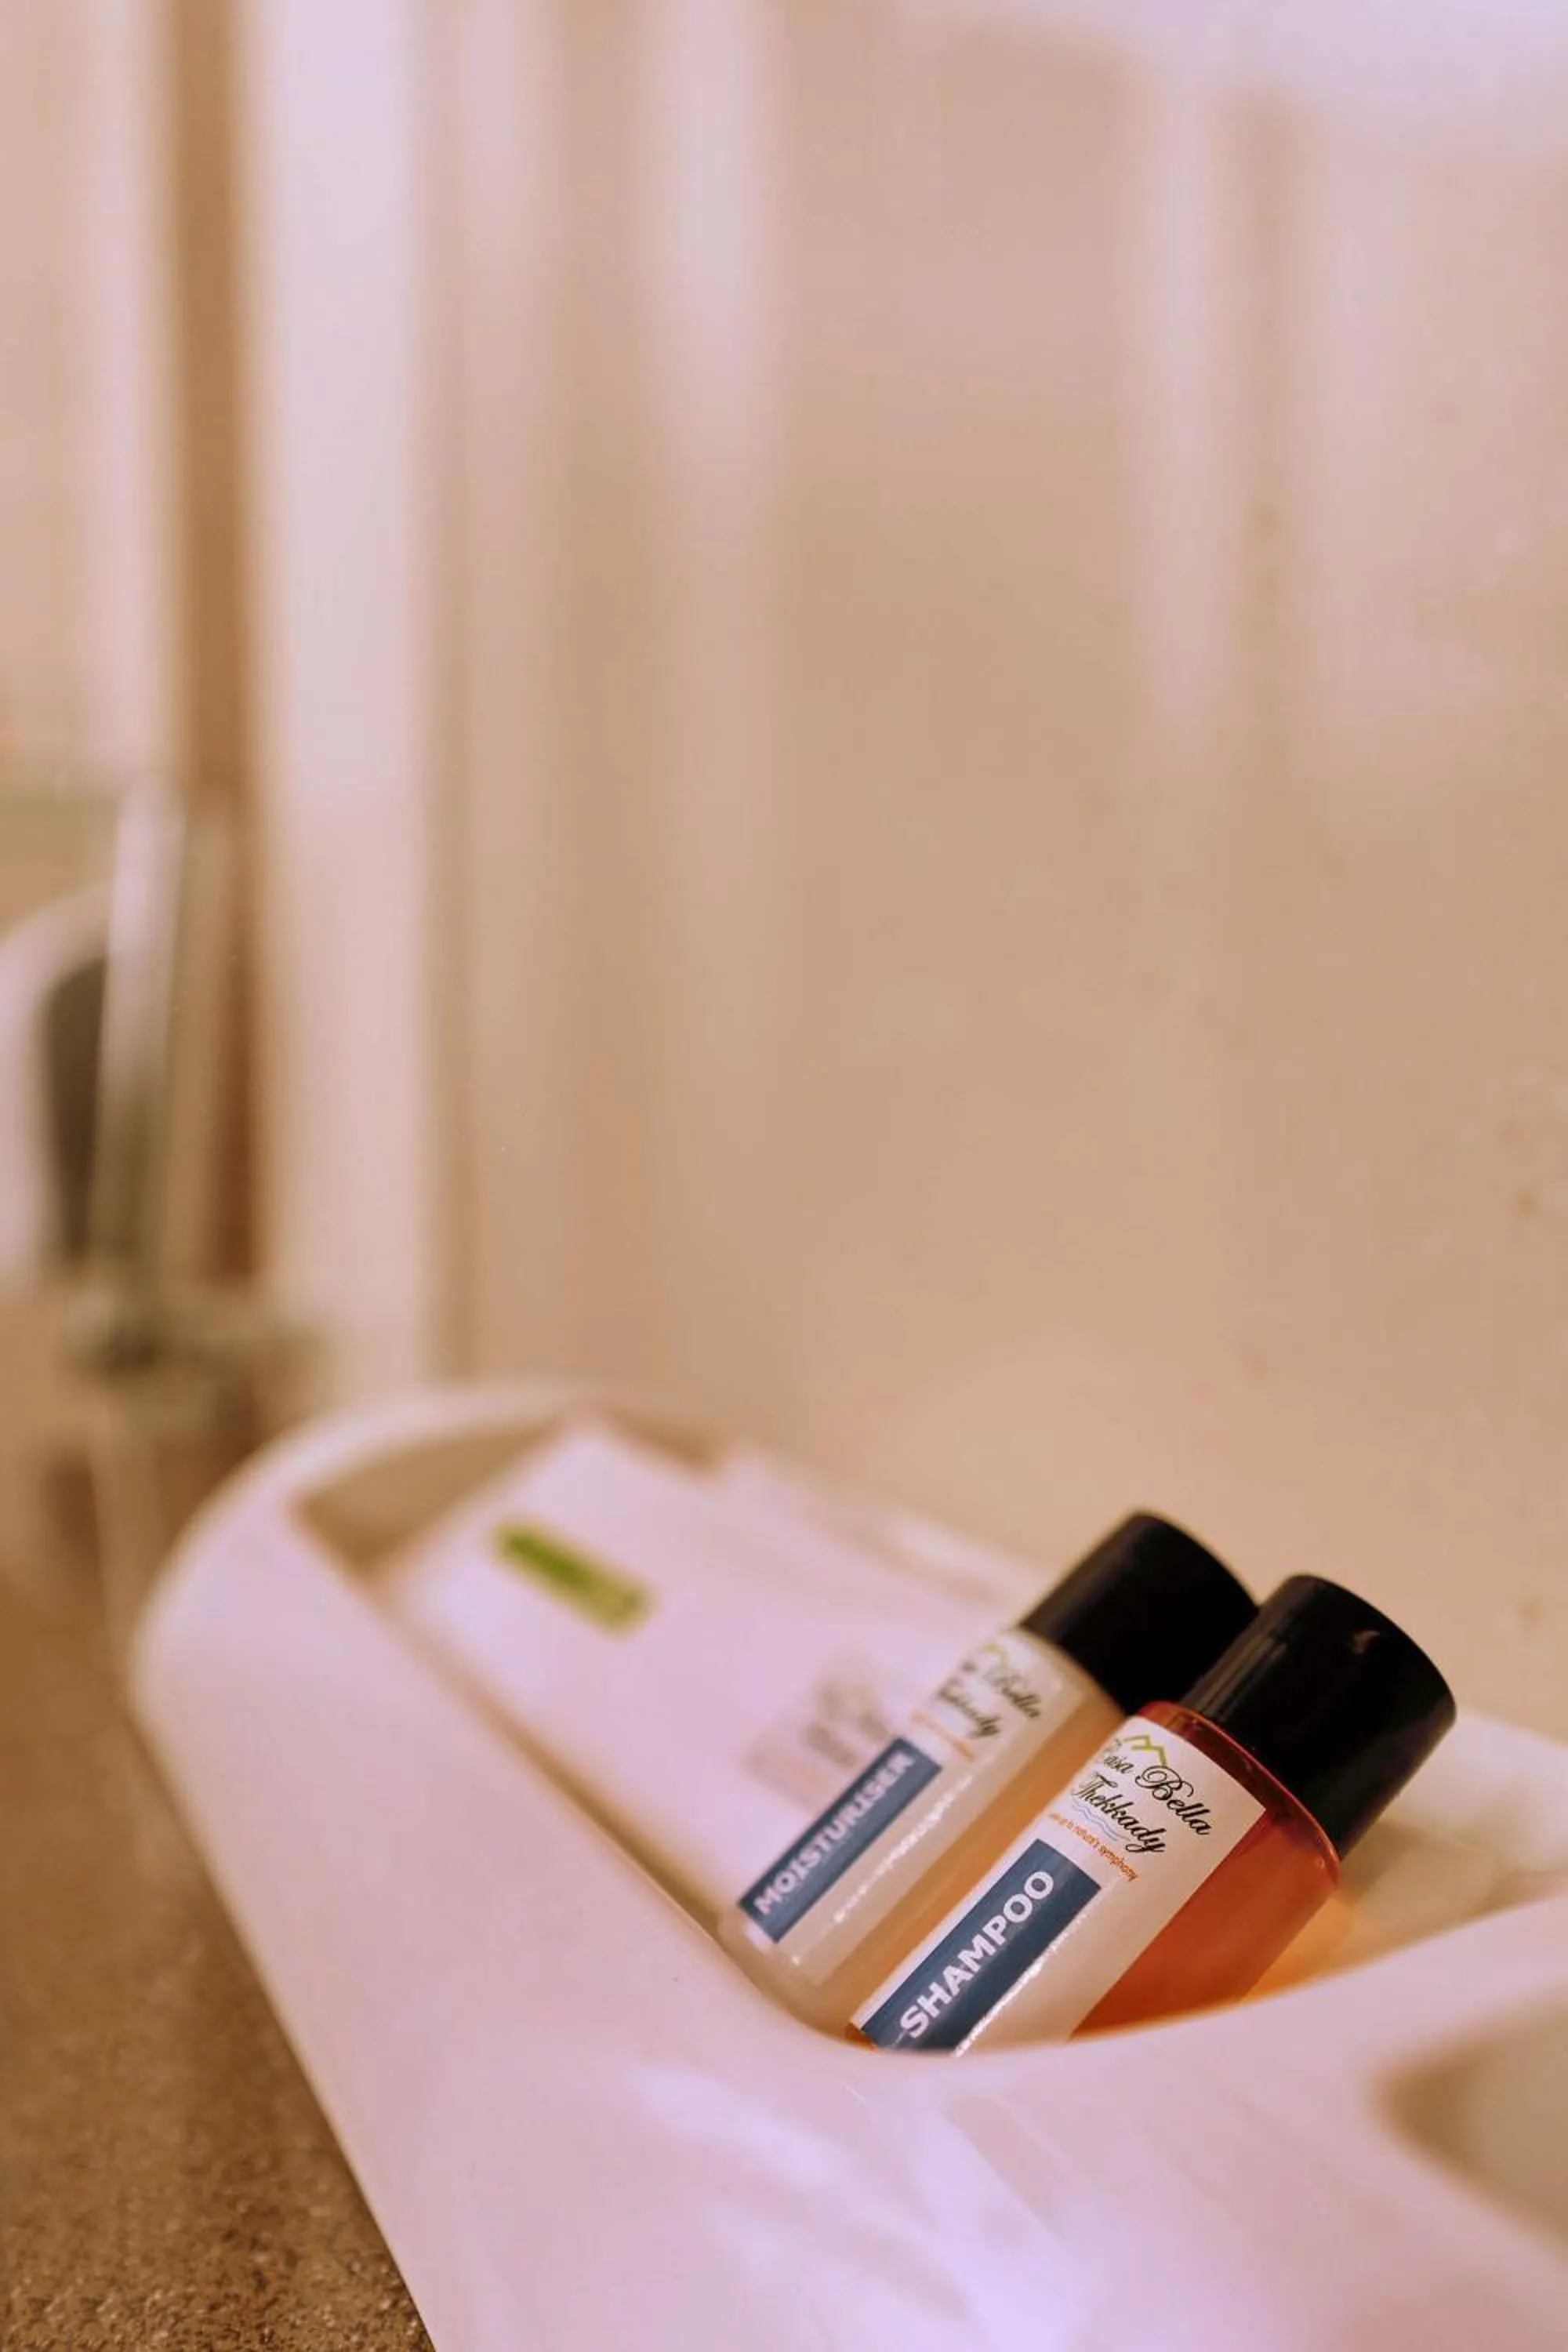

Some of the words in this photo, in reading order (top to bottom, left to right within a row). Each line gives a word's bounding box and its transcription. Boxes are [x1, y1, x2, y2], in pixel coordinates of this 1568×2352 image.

[753, 1751, 914, 1915] MOISTURISER
[1070, 1771, 1167, 1853] Thekkady
[1134, 1765, 1212, 1835] Bella
[1098, 1845, 1138, 1882] symphony
[899, 1871, 1054, 2038] SHAMPOO
